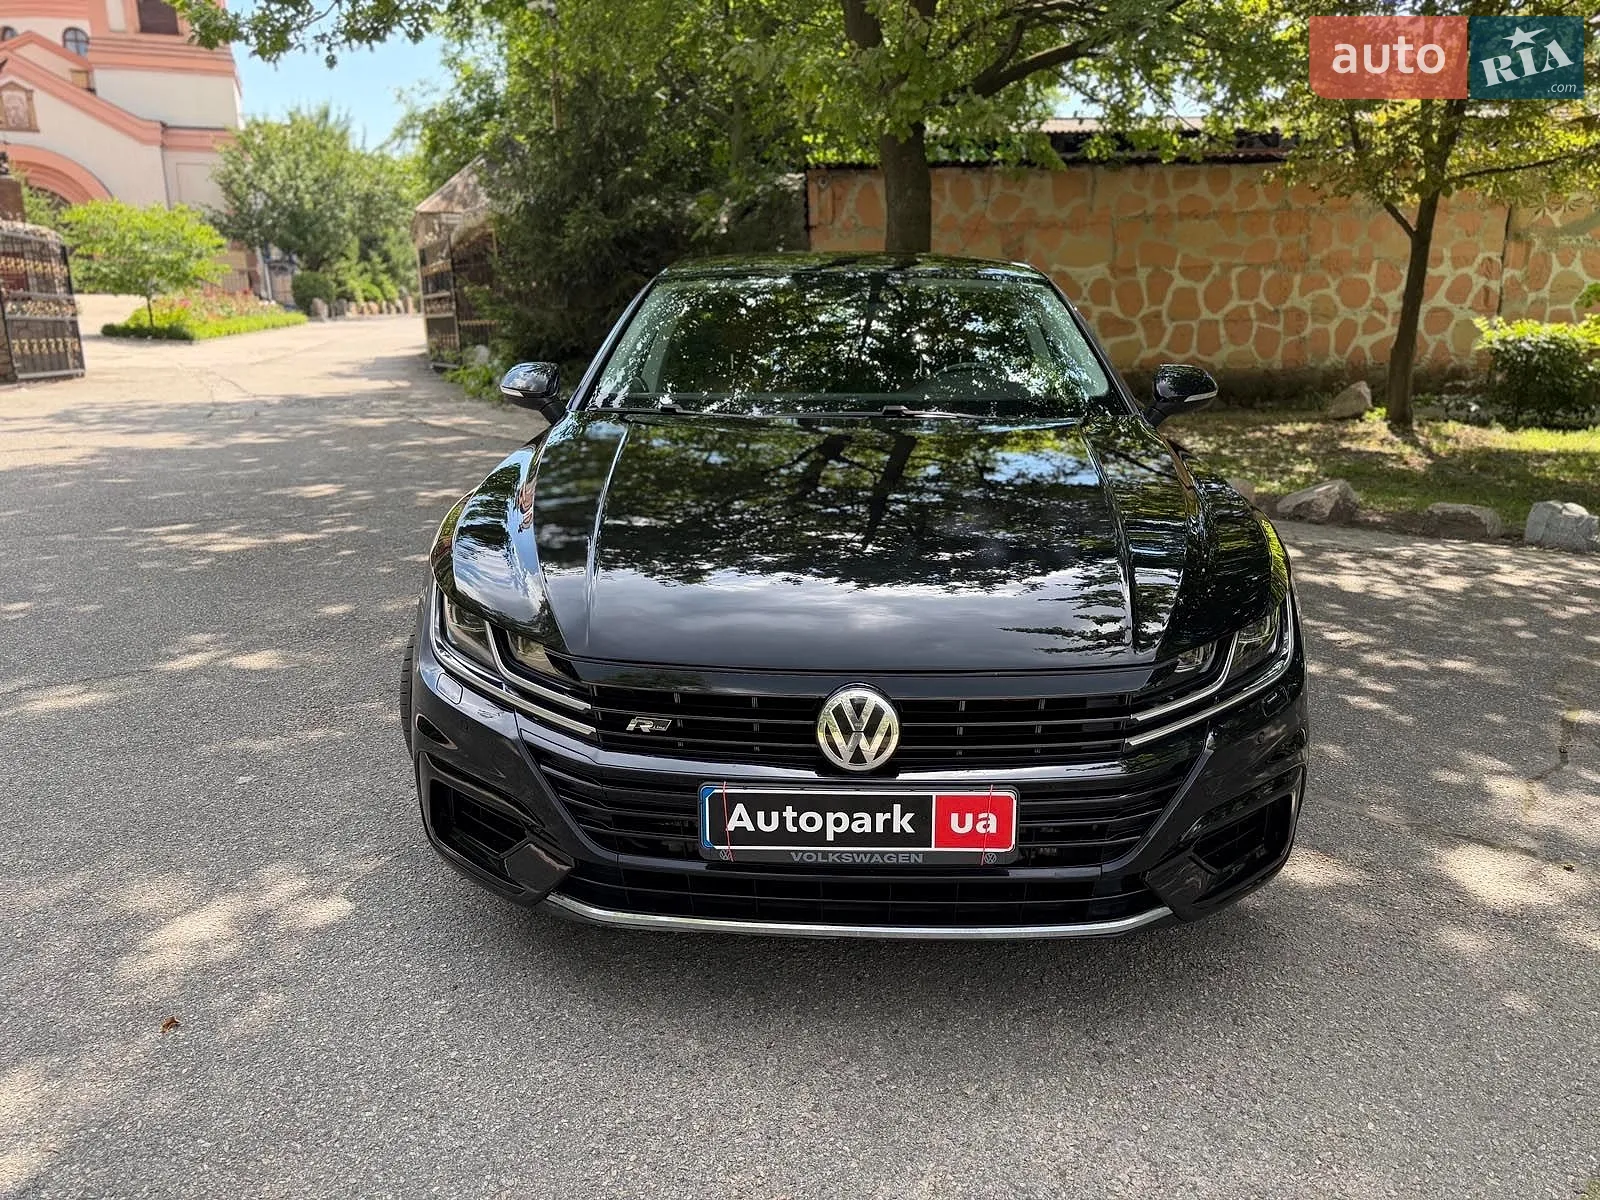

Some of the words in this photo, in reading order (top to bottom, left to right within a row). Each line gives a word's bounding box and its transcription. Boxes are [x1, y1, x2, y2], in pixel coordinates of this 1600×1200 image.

[726, 803, 915, 841] Autopark
[950, 812, 997, 834] ua
[790, 851, 923, 864] VOLKSWAGEN
